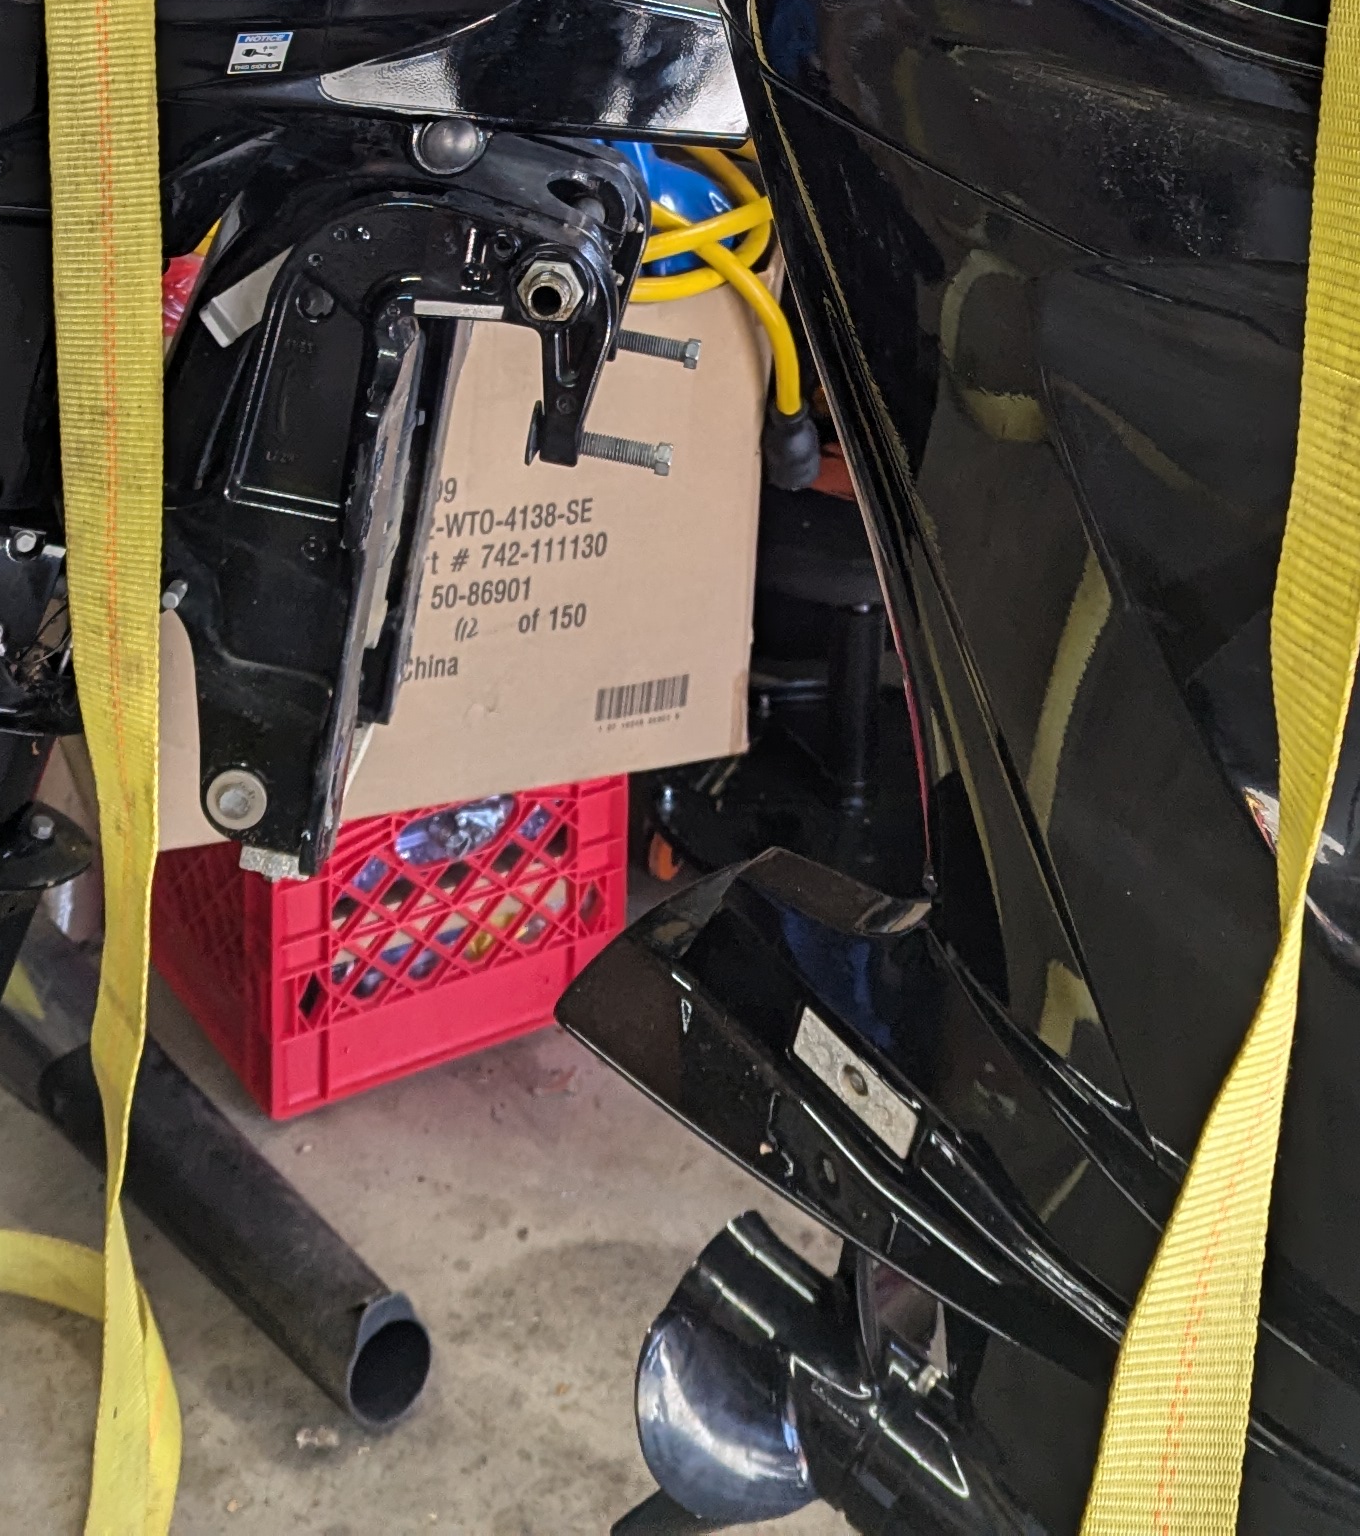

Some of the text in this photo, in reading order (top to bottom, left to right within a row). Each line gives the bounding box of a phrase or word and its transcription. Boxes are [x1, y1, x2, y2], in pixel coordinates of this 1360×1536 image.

[451, 548, 470, 572] #
[481, 531, 608, 569] 742-111130
[431, 576, 532, 610] 50-86901
[518, 603, 588, 633] of 150
